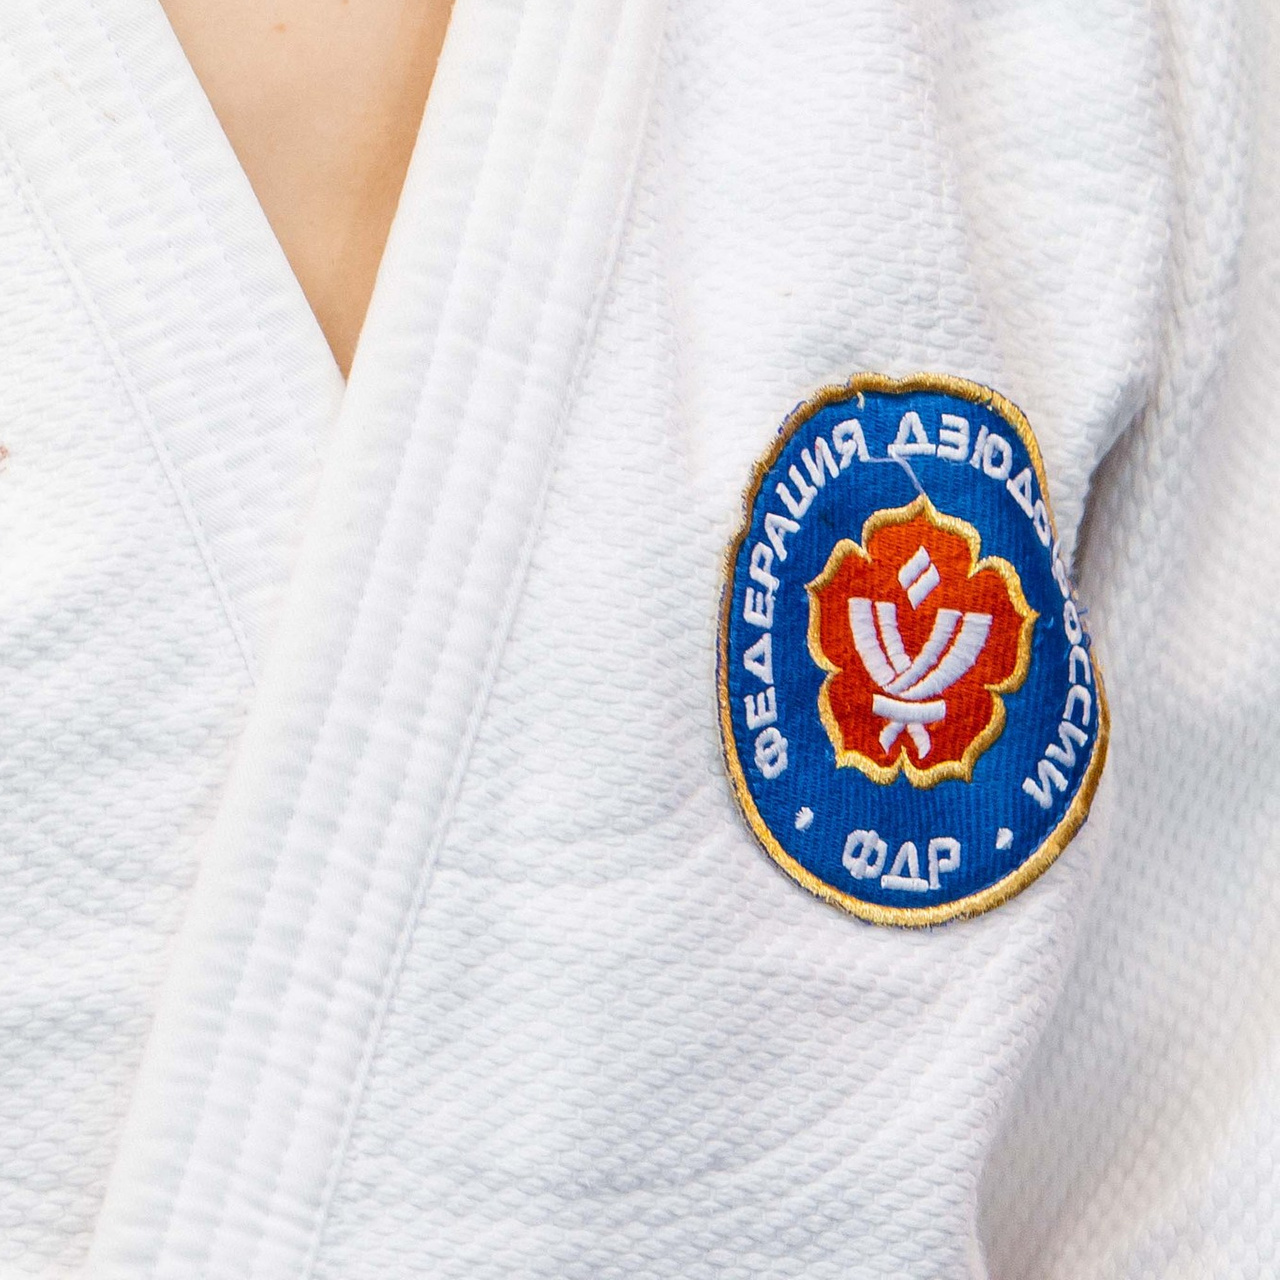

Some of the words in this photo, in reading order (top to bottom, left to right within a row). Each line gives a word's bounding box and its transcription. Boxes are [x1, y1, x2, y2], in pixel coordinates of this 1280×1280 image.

[743, 417, 870, 780] ФЕДЕРАЦИЯ
[888, 411, 1052, 547] ДЗЮДО
[842, 828, 961, 893] ФДР
